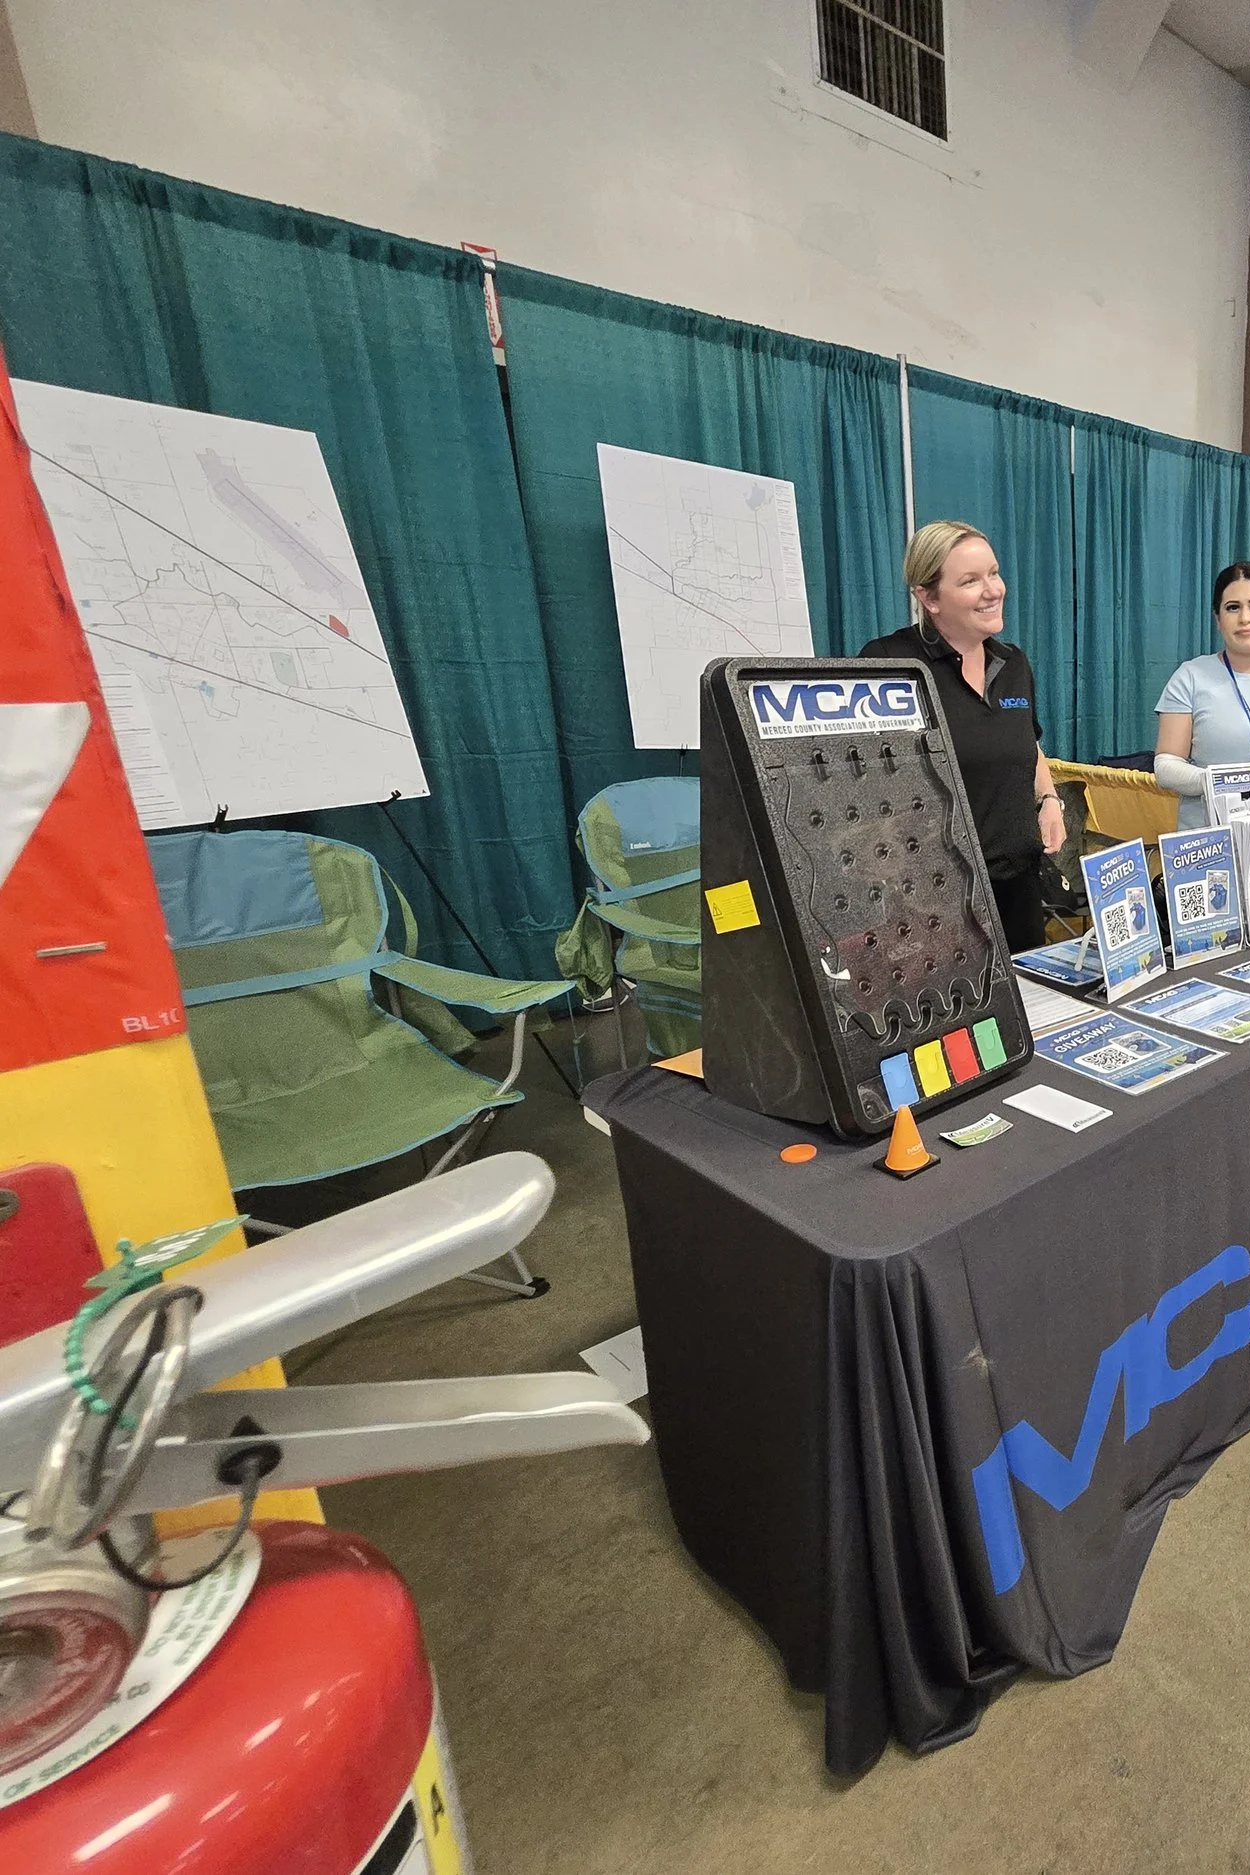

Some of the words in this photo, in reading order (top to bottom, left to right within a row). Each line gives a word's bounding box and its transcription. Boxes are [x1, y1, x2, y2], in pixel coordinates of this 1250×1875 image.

[752, 683, 917, 723] MCAG
[762, 724, 792, 736] MERCED
[794, 723, 822, 735] COUNTY
[823, 720, 867, 732] ASSOCIATION
[868, 720, 877, 729] OF
[1223, 774, 1250, 785] MCAG
[1173, 842, 1224, 869] GIVEAWAY
[1180, 839, 1200, 851] MCAG
[1100, 859, 1135, 889] SORTEO
[1053, 1029, 1081, 1044] MCAG
[1053, 1021, 1117, 1054] GIVEAWAY
